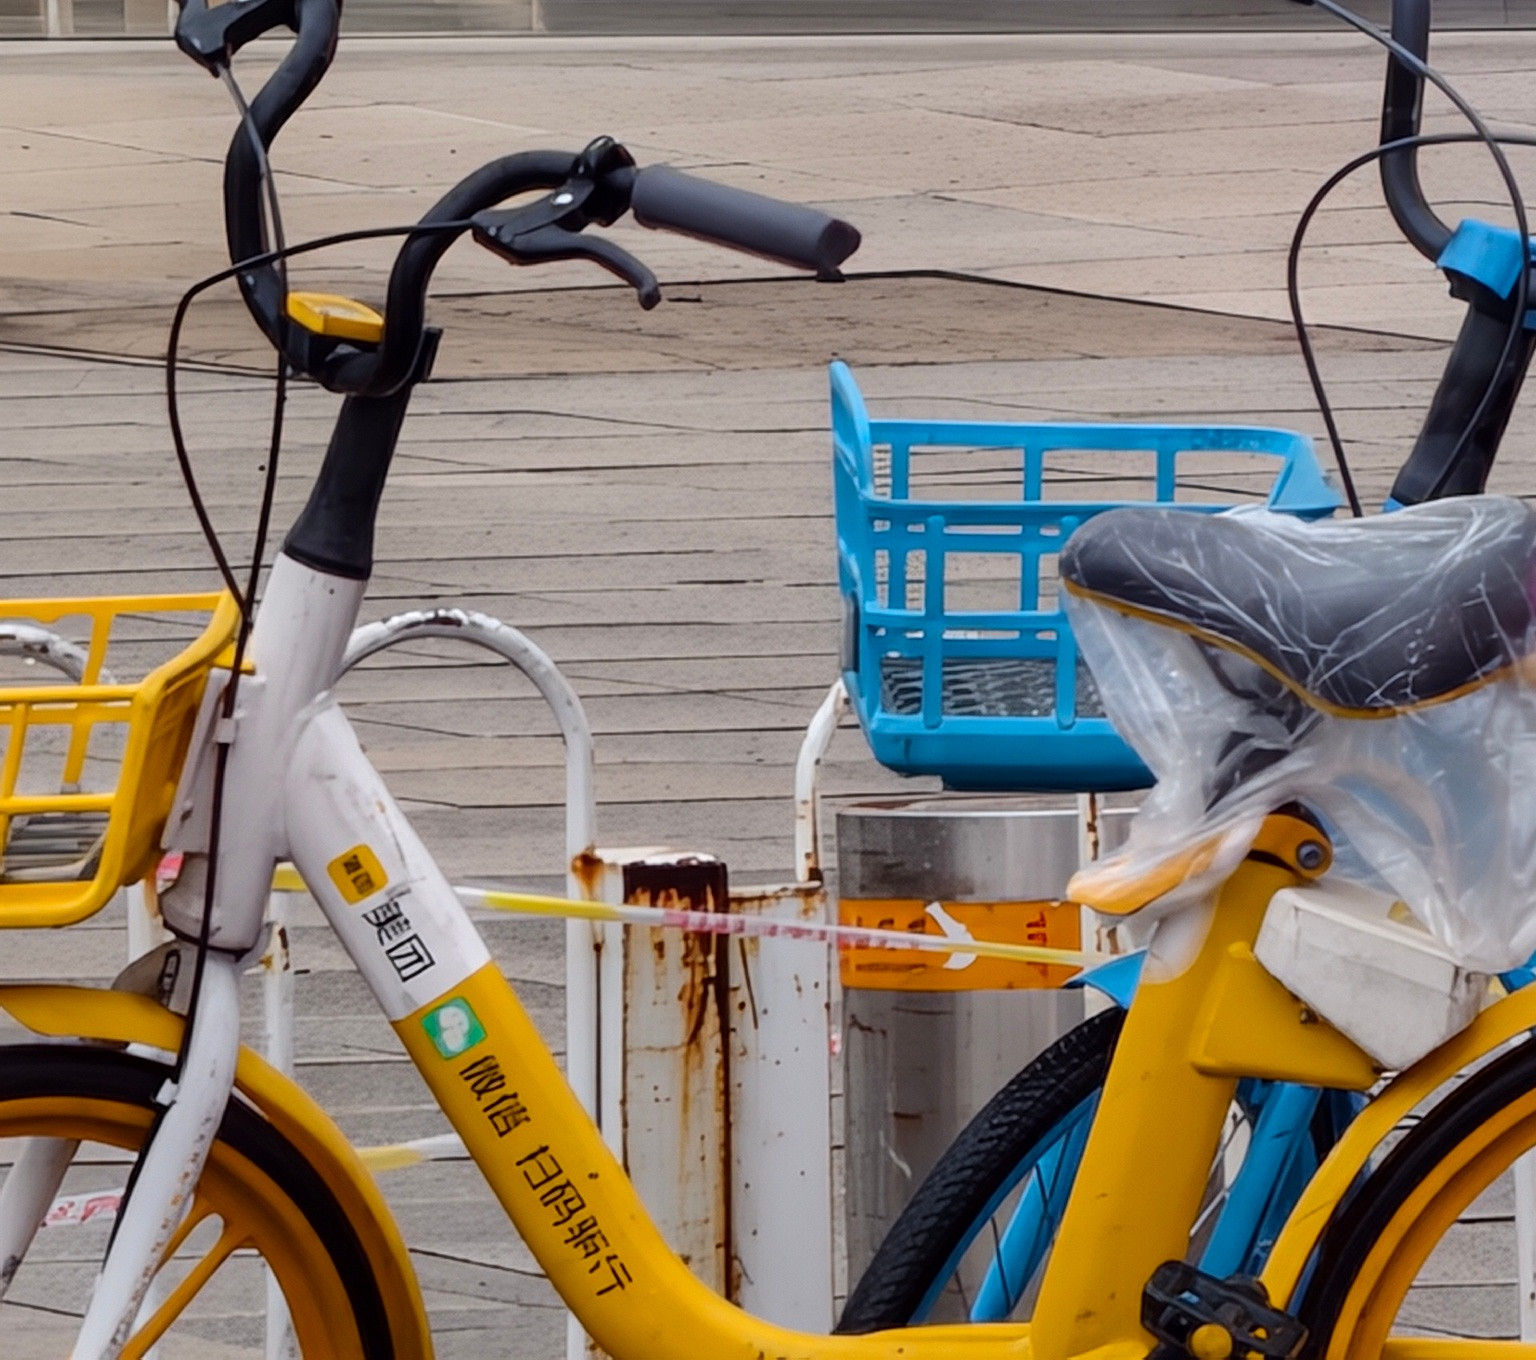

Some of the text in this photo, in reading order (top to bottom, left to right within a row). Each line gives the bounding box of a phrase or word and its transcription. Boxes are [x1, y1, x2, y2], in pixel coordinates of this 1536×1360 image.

[362, 894, 435, 982] 美团
[458, 1053, 634, 1297] 微信 扫码骑行
